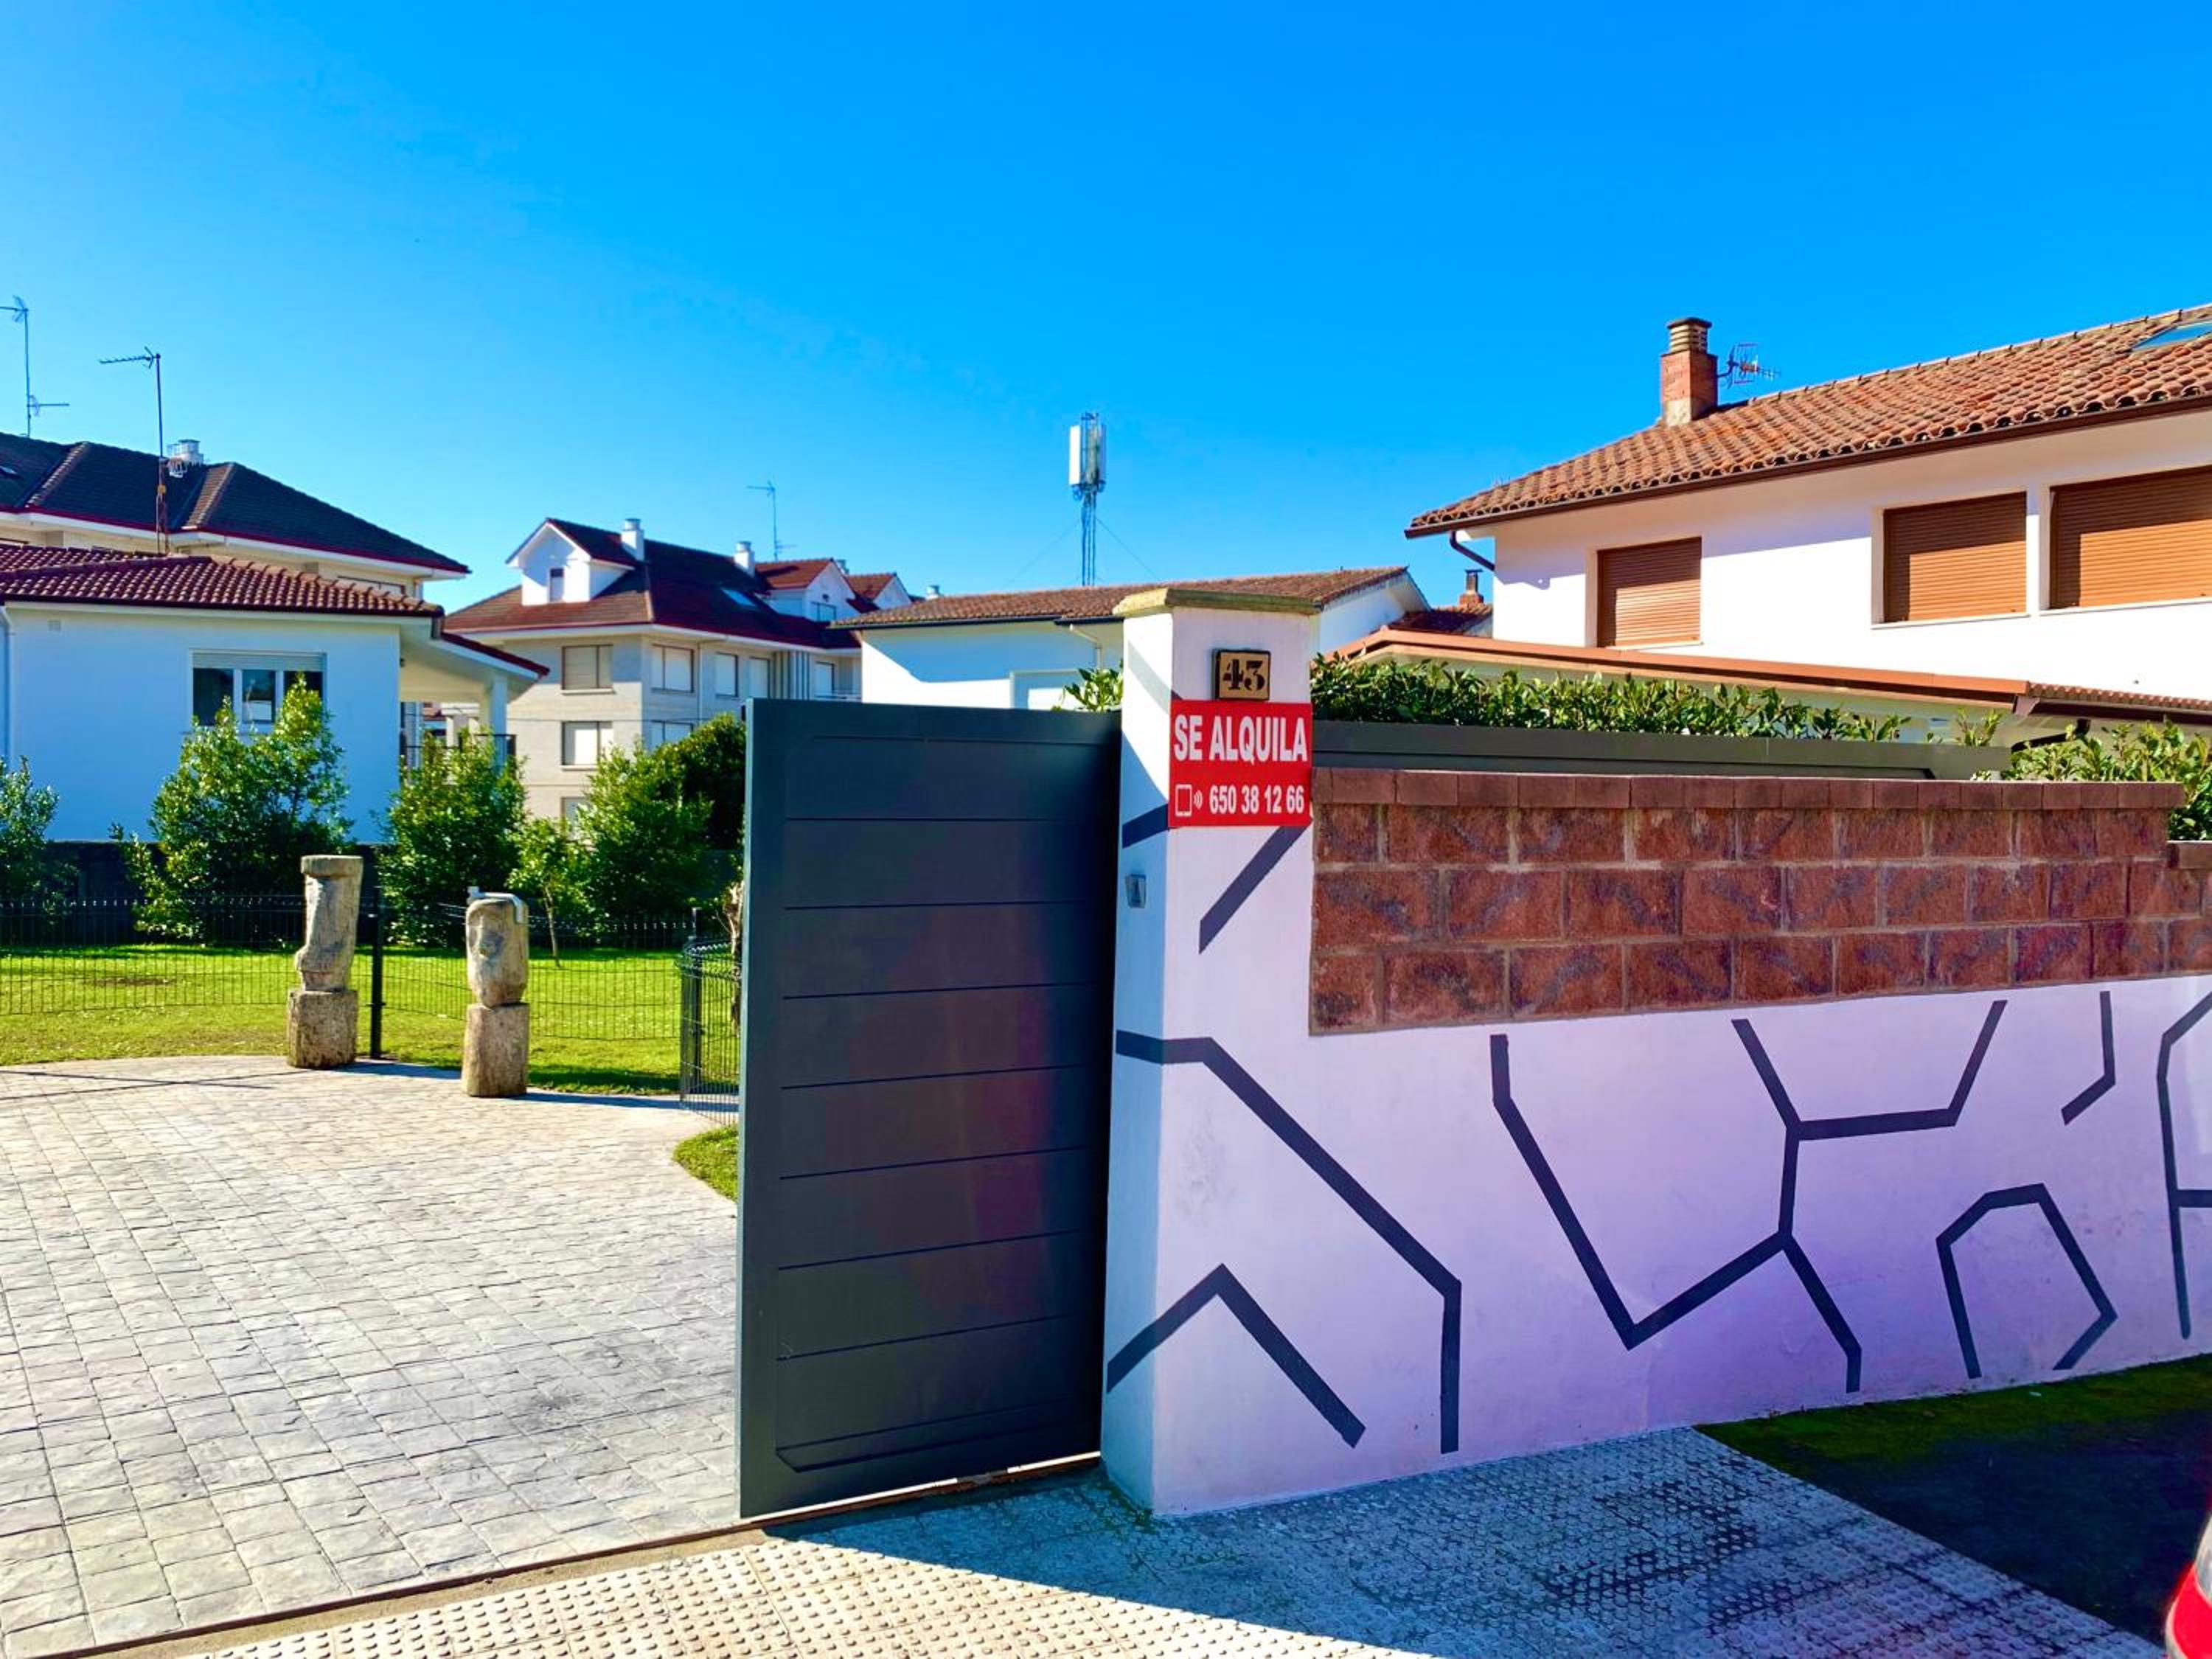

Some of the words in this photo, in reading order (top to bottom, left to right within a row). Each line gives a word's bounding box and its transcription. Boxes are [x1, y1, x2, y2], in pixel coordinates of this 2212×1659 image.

[1222, 659, 1265, 691] 43
[1174, 714, 1203, 761] SE
[1208, 716, 1307, 765] ALQUILA
[1209, 785, 1237, 814] 650
[1241, 785, 1259, 814] 38
[1265, 785, 1281, 813] 12
[1286, 785, 1304, 814] 66
